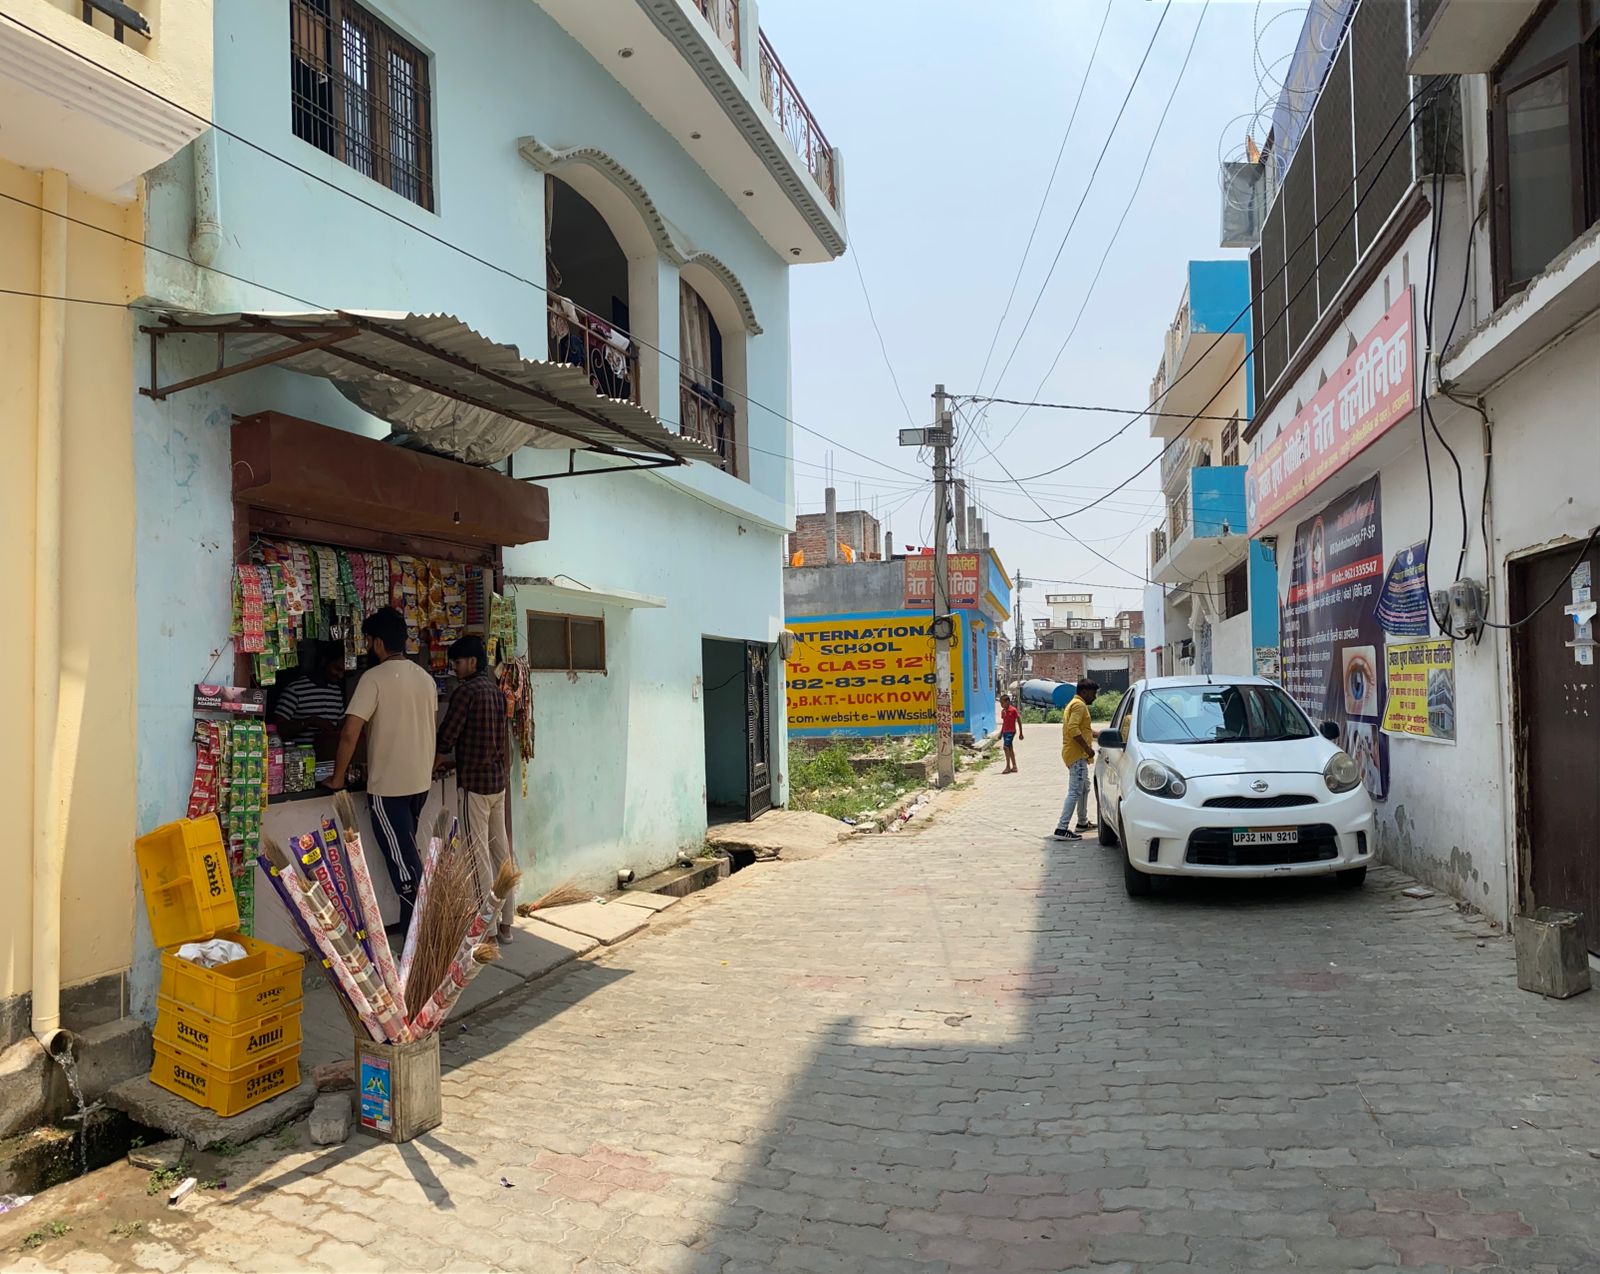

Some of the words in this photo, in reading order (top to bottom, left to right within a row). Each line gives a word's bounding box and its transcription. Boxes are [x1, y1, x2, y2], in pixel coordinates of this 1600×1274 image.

[820, 641, 902, 656] SCHOOL
[790, 663, 810, 673] To
[817, 659, 886, 672] CLASS
[1233, 833, 1256, 843] UP32
[1259, 832, 1273, 842] HN
[1276, 831, 1297, 842] 9210
